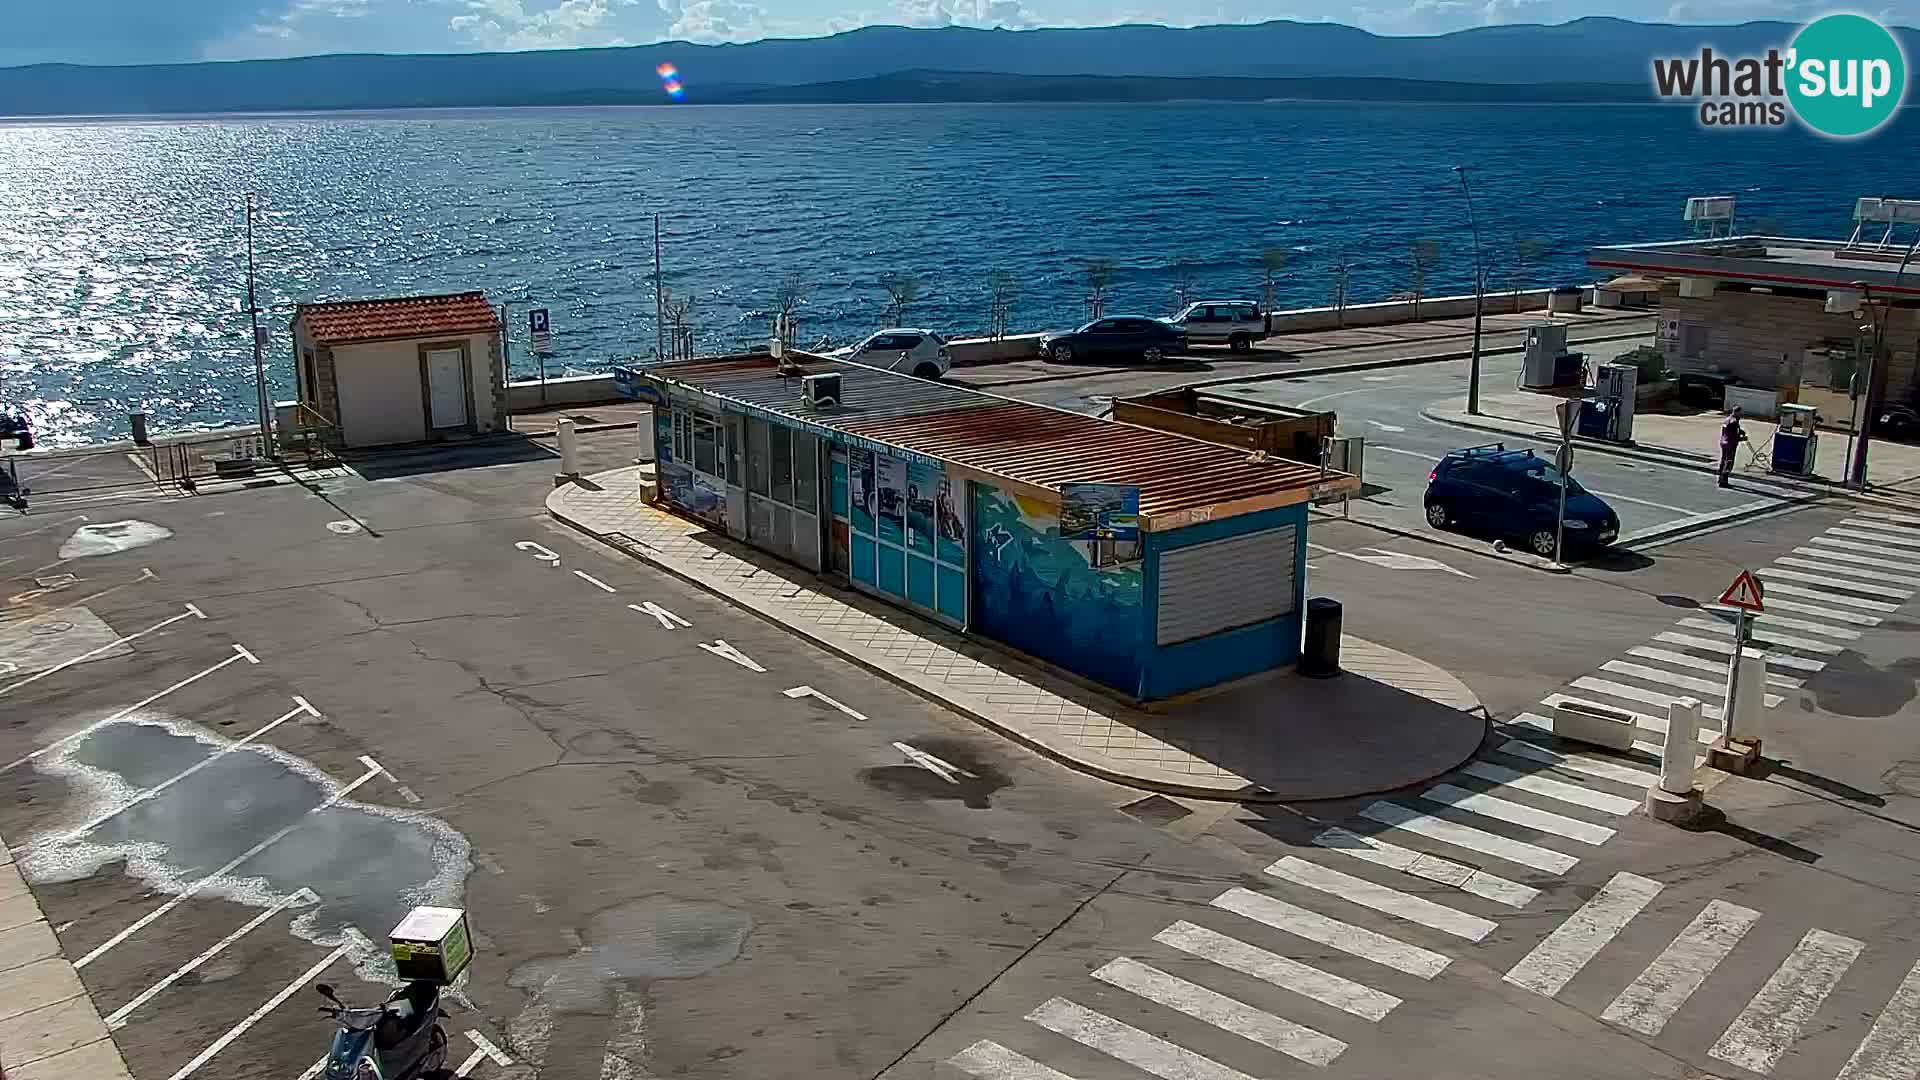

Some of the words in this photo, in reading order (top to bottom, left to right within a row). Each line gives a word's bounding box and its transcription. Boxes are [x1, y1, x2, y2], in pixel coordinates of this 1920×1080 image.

[533, 312, 545, 329] P
[891, 447, 914, 462] TICKET
[916, 454, 942, 469] OFFICE
